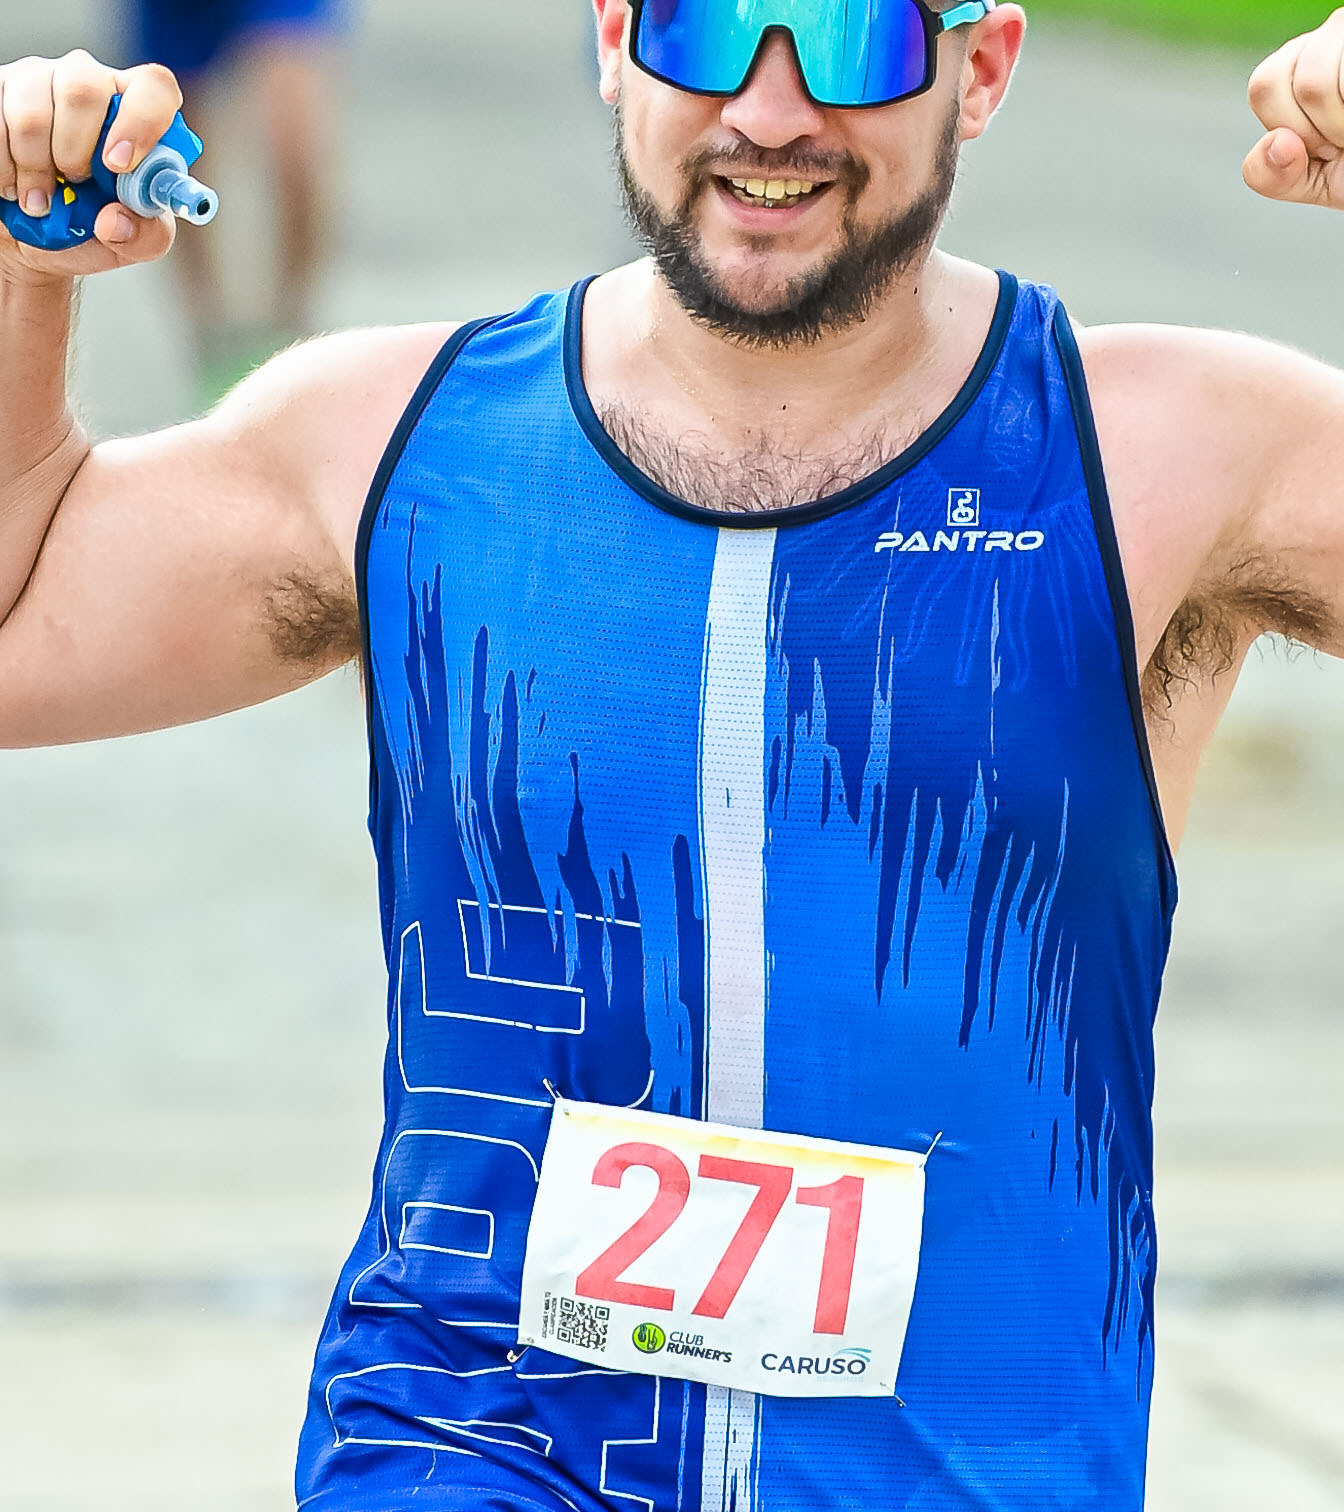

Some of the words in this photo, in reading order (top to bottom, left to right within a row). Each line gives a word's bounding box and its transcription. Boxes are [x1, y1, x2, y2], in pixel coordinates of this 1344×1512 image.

[873, 529, 1046, 554] PANTRO
[574, 1141, 865, 1336] 271
[669, 1330, 704, 1346] CLUB
[665, 1341, 733, 1363] RUNNER'S
[760, 1352, 866, 1375] CARUSO
